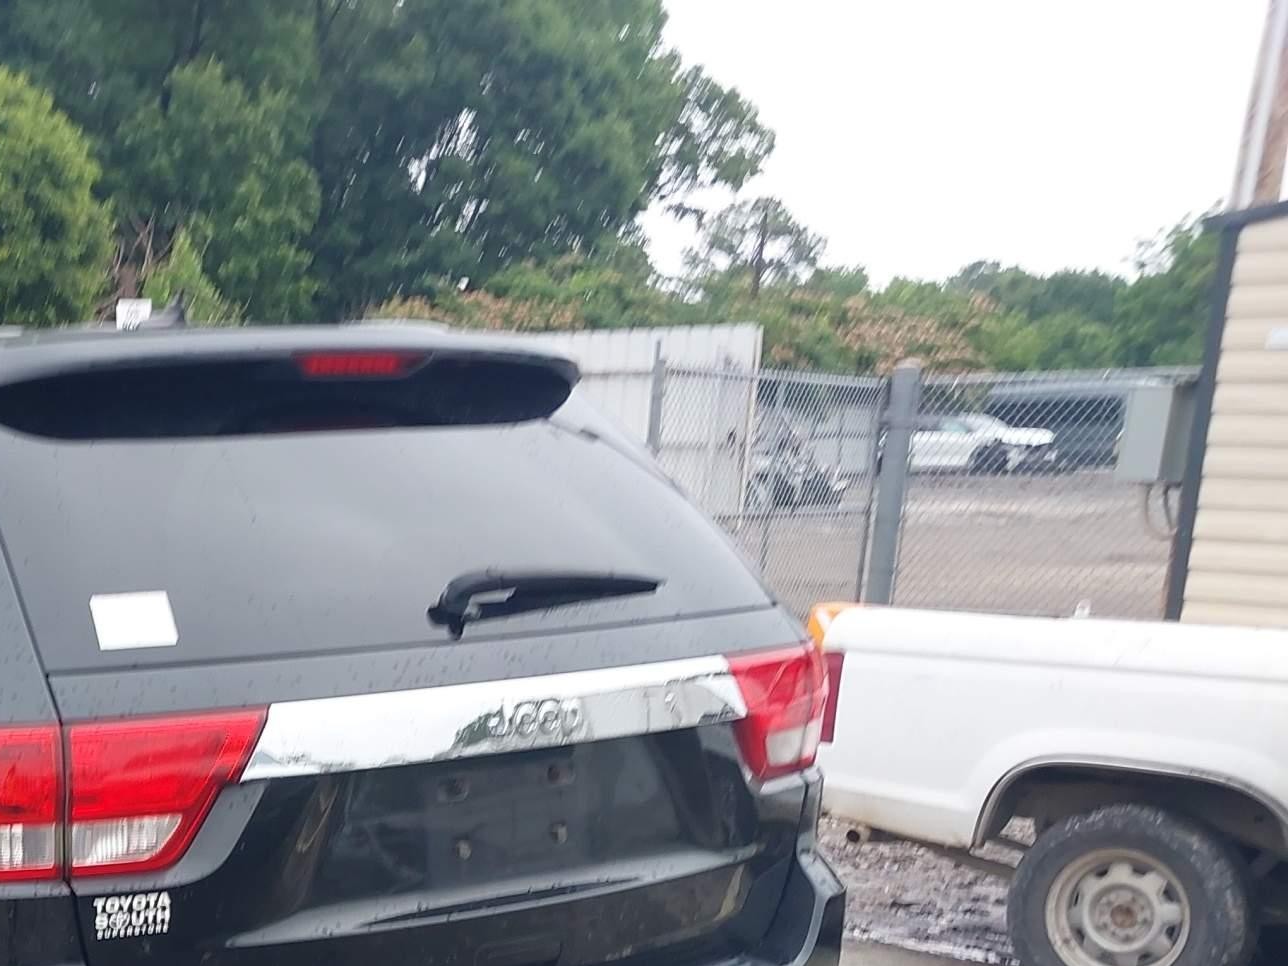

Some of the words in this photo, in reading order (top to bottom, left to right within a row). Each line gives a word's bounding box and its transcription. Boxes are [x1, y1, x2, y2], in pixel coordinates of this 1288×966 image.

[487, 697, 583, 745] Jeep
[93, 891, 171, 914] TOYOTA
[95, 907, 171, 930] SOUTH
